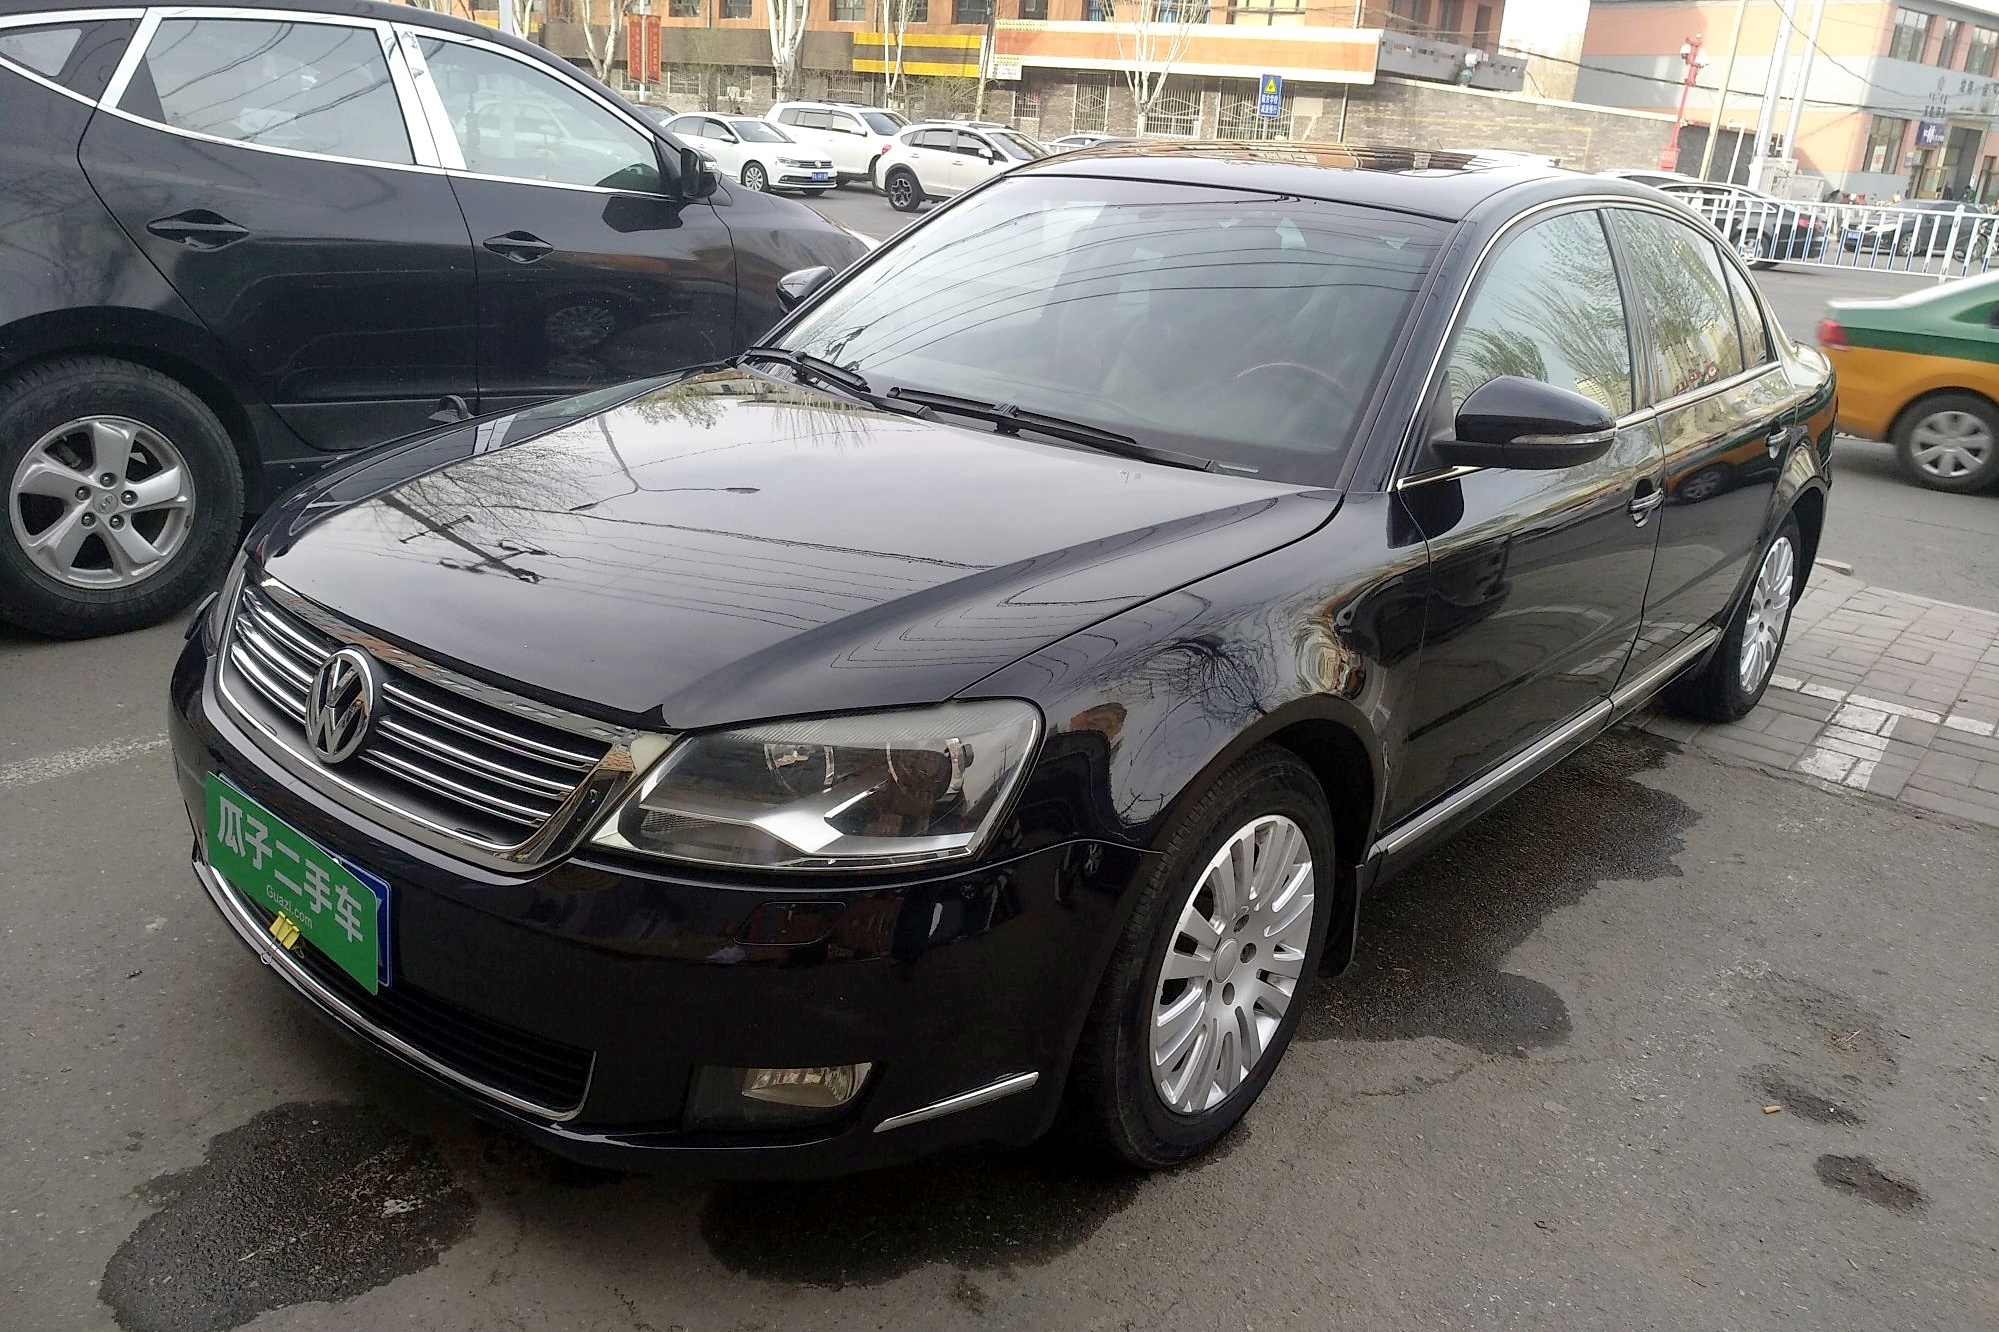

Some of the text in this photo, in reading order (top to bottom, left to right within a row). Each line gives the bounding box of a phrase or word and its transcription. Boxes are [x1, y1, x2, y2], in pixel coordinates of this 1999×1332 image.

[218, 796, 363, 942] 瓜子二手车
[266, 884, 313, 929] Guazi.com
